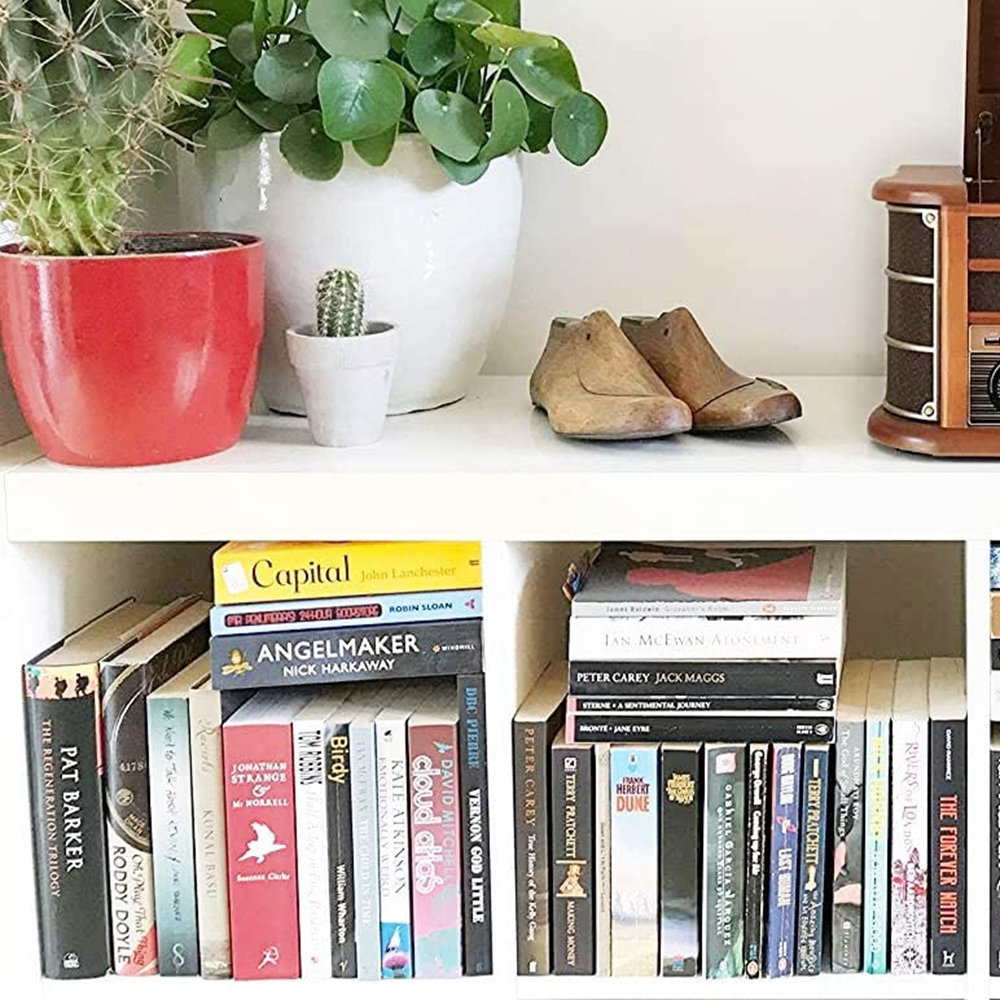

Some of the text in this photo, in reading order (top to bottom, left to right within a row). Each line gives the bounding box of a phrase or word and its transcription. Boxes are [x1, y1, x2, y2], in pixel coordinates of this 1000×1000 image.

[252, 555, 457, 593] Capital John Lanchester
[389, 602, 453, 614] ROBIN SLOAN
[256, 633, 420, 663] ANGELMAKER
[710, 633, 800, 647] ATONEMENT
[283, 659, 396, 678] NICK HARKAWAY
[576, 672, 726, 684] PETER CAREY JACK MAGGS
[582, 701, 611, 710] STERNE
[625, 701, 675, 710] SENTIMENTAL
[676, 701, 711, 710] JOURNEY
[613, 724, 631, 734] JANE
[632, 724, 651, 733] EYRE
[231, 762, 288, 775] JONATHAN
[231, 773, 287, 785] STRANGE
[298, 730, 323, 785] TOM ROBBINS
[441, 760, 454, 805] DAVID
[523, 728, 536, 827] PETER CAREY
[752, 750, 764, 805] George Orwell
[41, 719, 61, 898] THE REGENERATION TRILOGY
[60, 746, 84, 873] PAT BARKER
[245, 798, 289, 807] NORRELL
[465, 687, 484, 923] DBC PIERRE VERNON GOD LITTLE
[616, 783, 650, 795] HERBERT
[616, 795, 650, 812] DUNE
[326, 735, 349, 944] Birdy William Wharton
[390, 759, 406, 894] KATE ATKINSON
[412, 755, 445, 894] cloud atlas
[805, 778, 822, 865] TERRY PRATCHETT
[202, 809, 218, 899] KUNAL BASU
[565, 774, 577, 965] TERRY PRATCHETT MAKING MONEY
[939, 795, 957, 934] THE FOREVER WATCH
[113, 846, 131, 964] RODDY DOYLE
